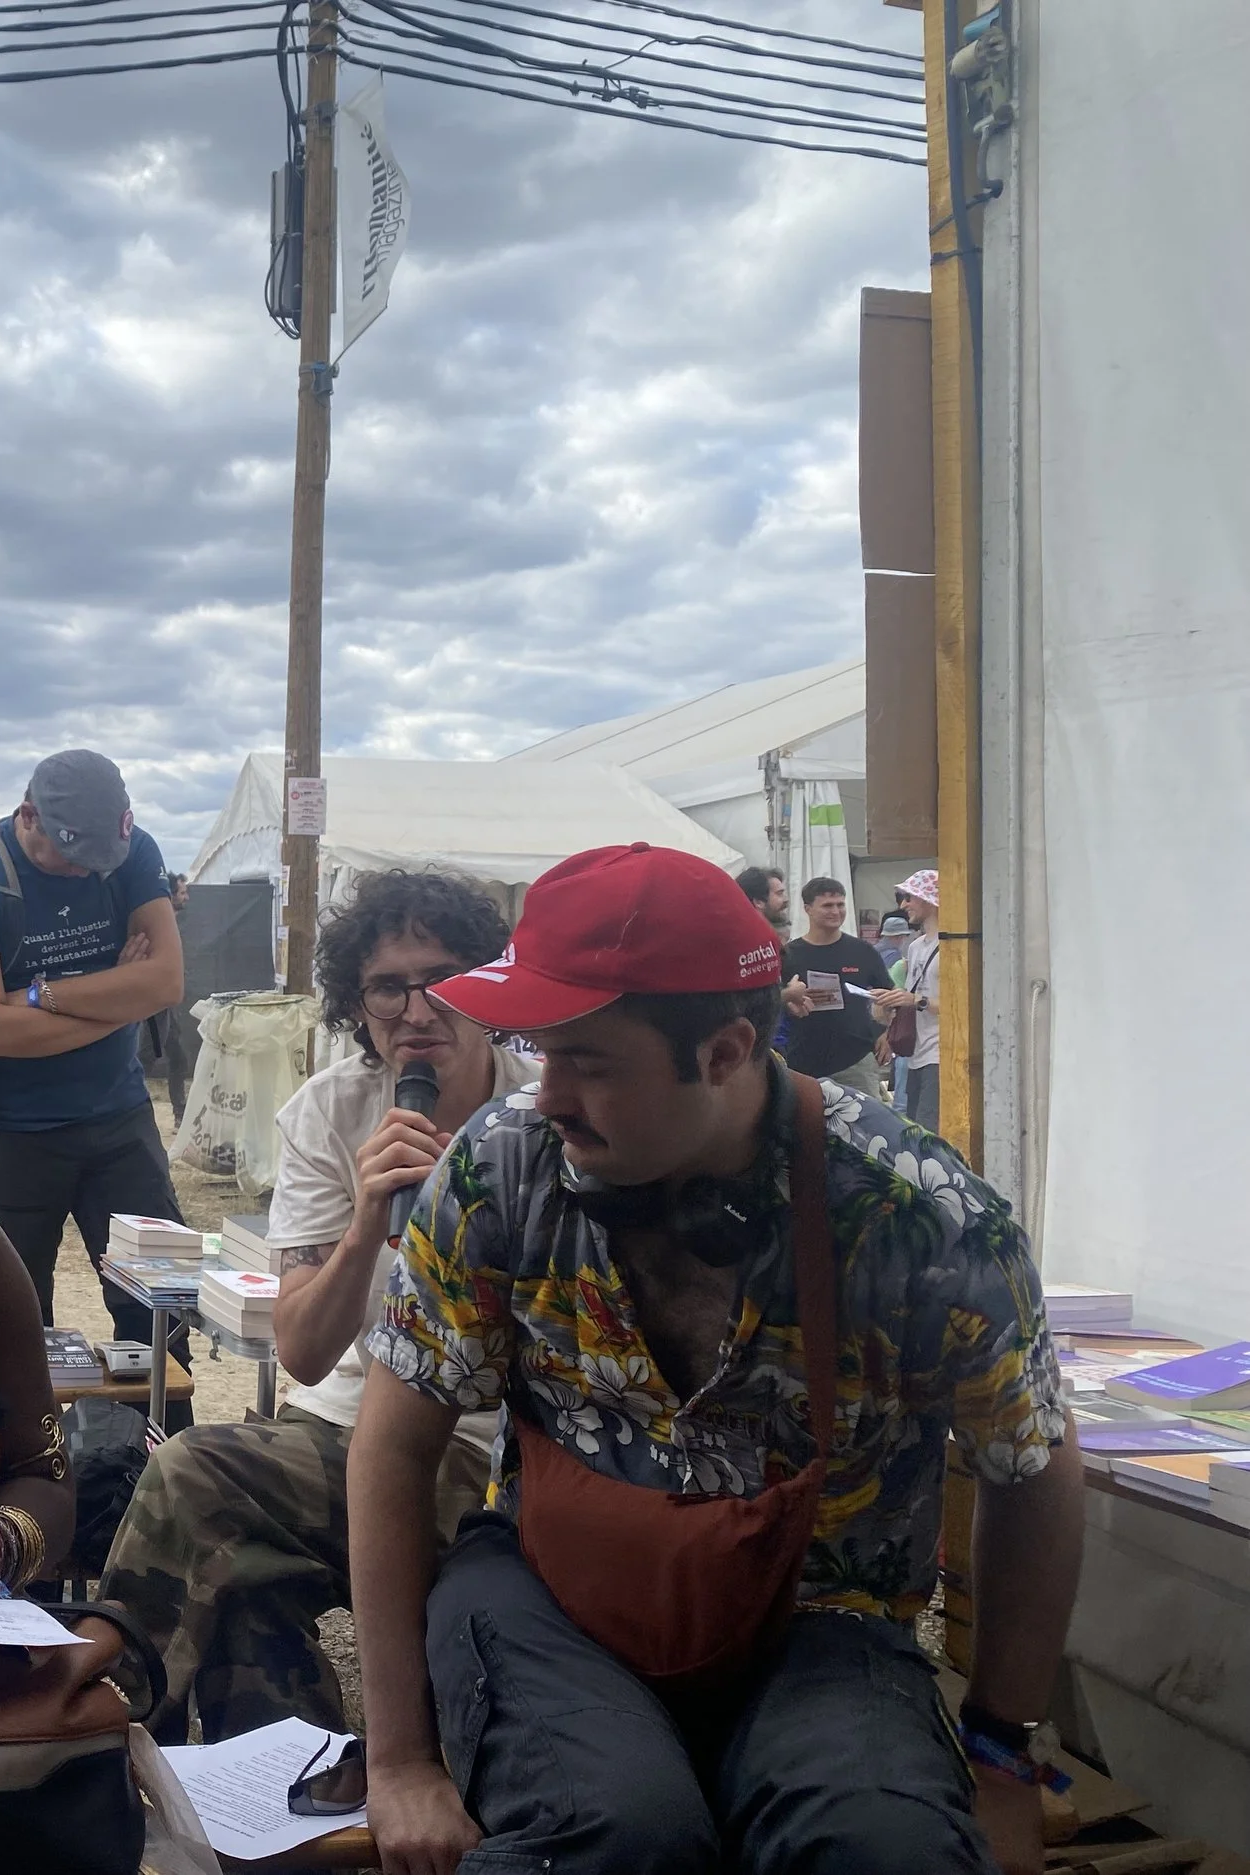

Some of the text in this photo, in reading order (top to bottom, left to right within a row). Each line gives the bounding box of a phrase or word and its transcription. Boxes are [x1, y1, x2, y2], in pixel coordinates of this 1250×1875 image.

[376, 159, 405, 265] magazine
[22, 919, 111, 945] Quand l'injustice
[25, 960, 38, 969] la
[41, 947, 98, 966] résistance
[41, 939, 79, 954] devient
[738, 940, 777, 966] cantal
